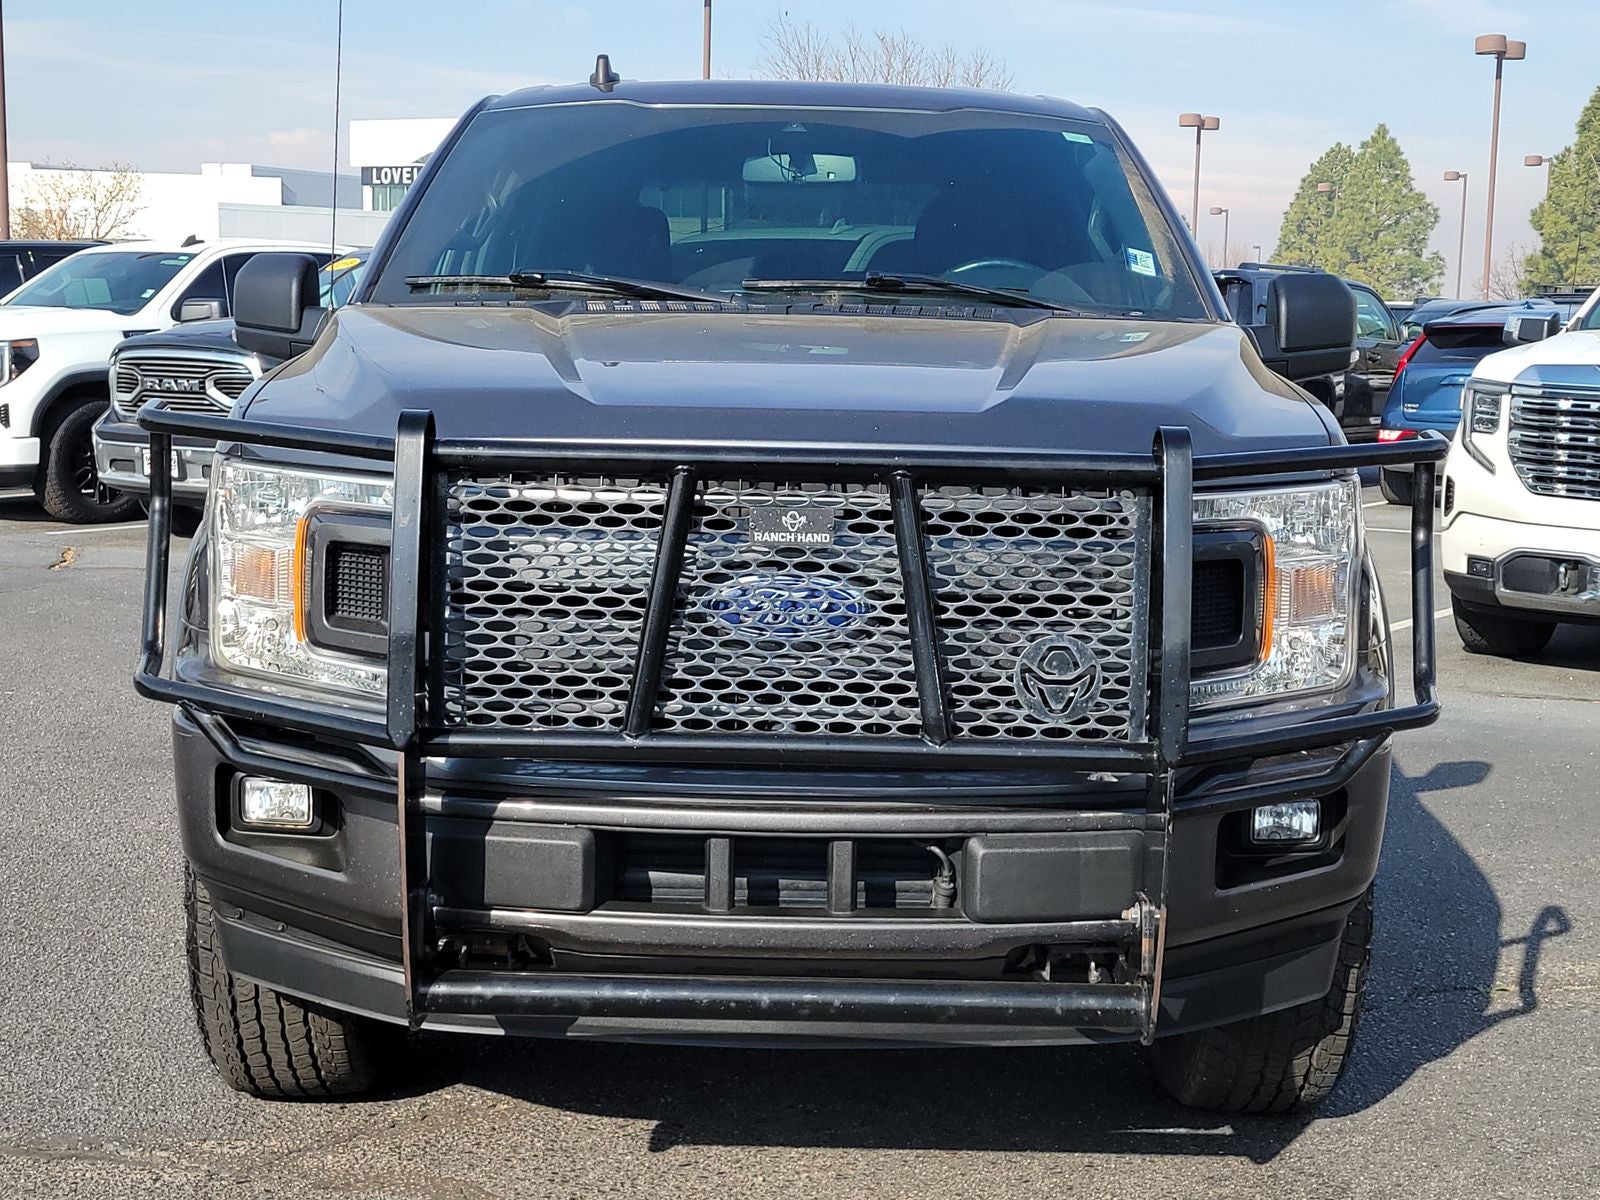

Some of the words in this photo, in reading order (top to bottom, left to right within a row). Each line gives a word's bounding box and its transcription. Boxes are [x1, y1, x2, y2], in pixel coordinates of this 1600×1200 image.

[143, 378, 199, 391] RAM
[754, 532, 793, 542] RANCH
[797, 533, 830, 543] HAND
